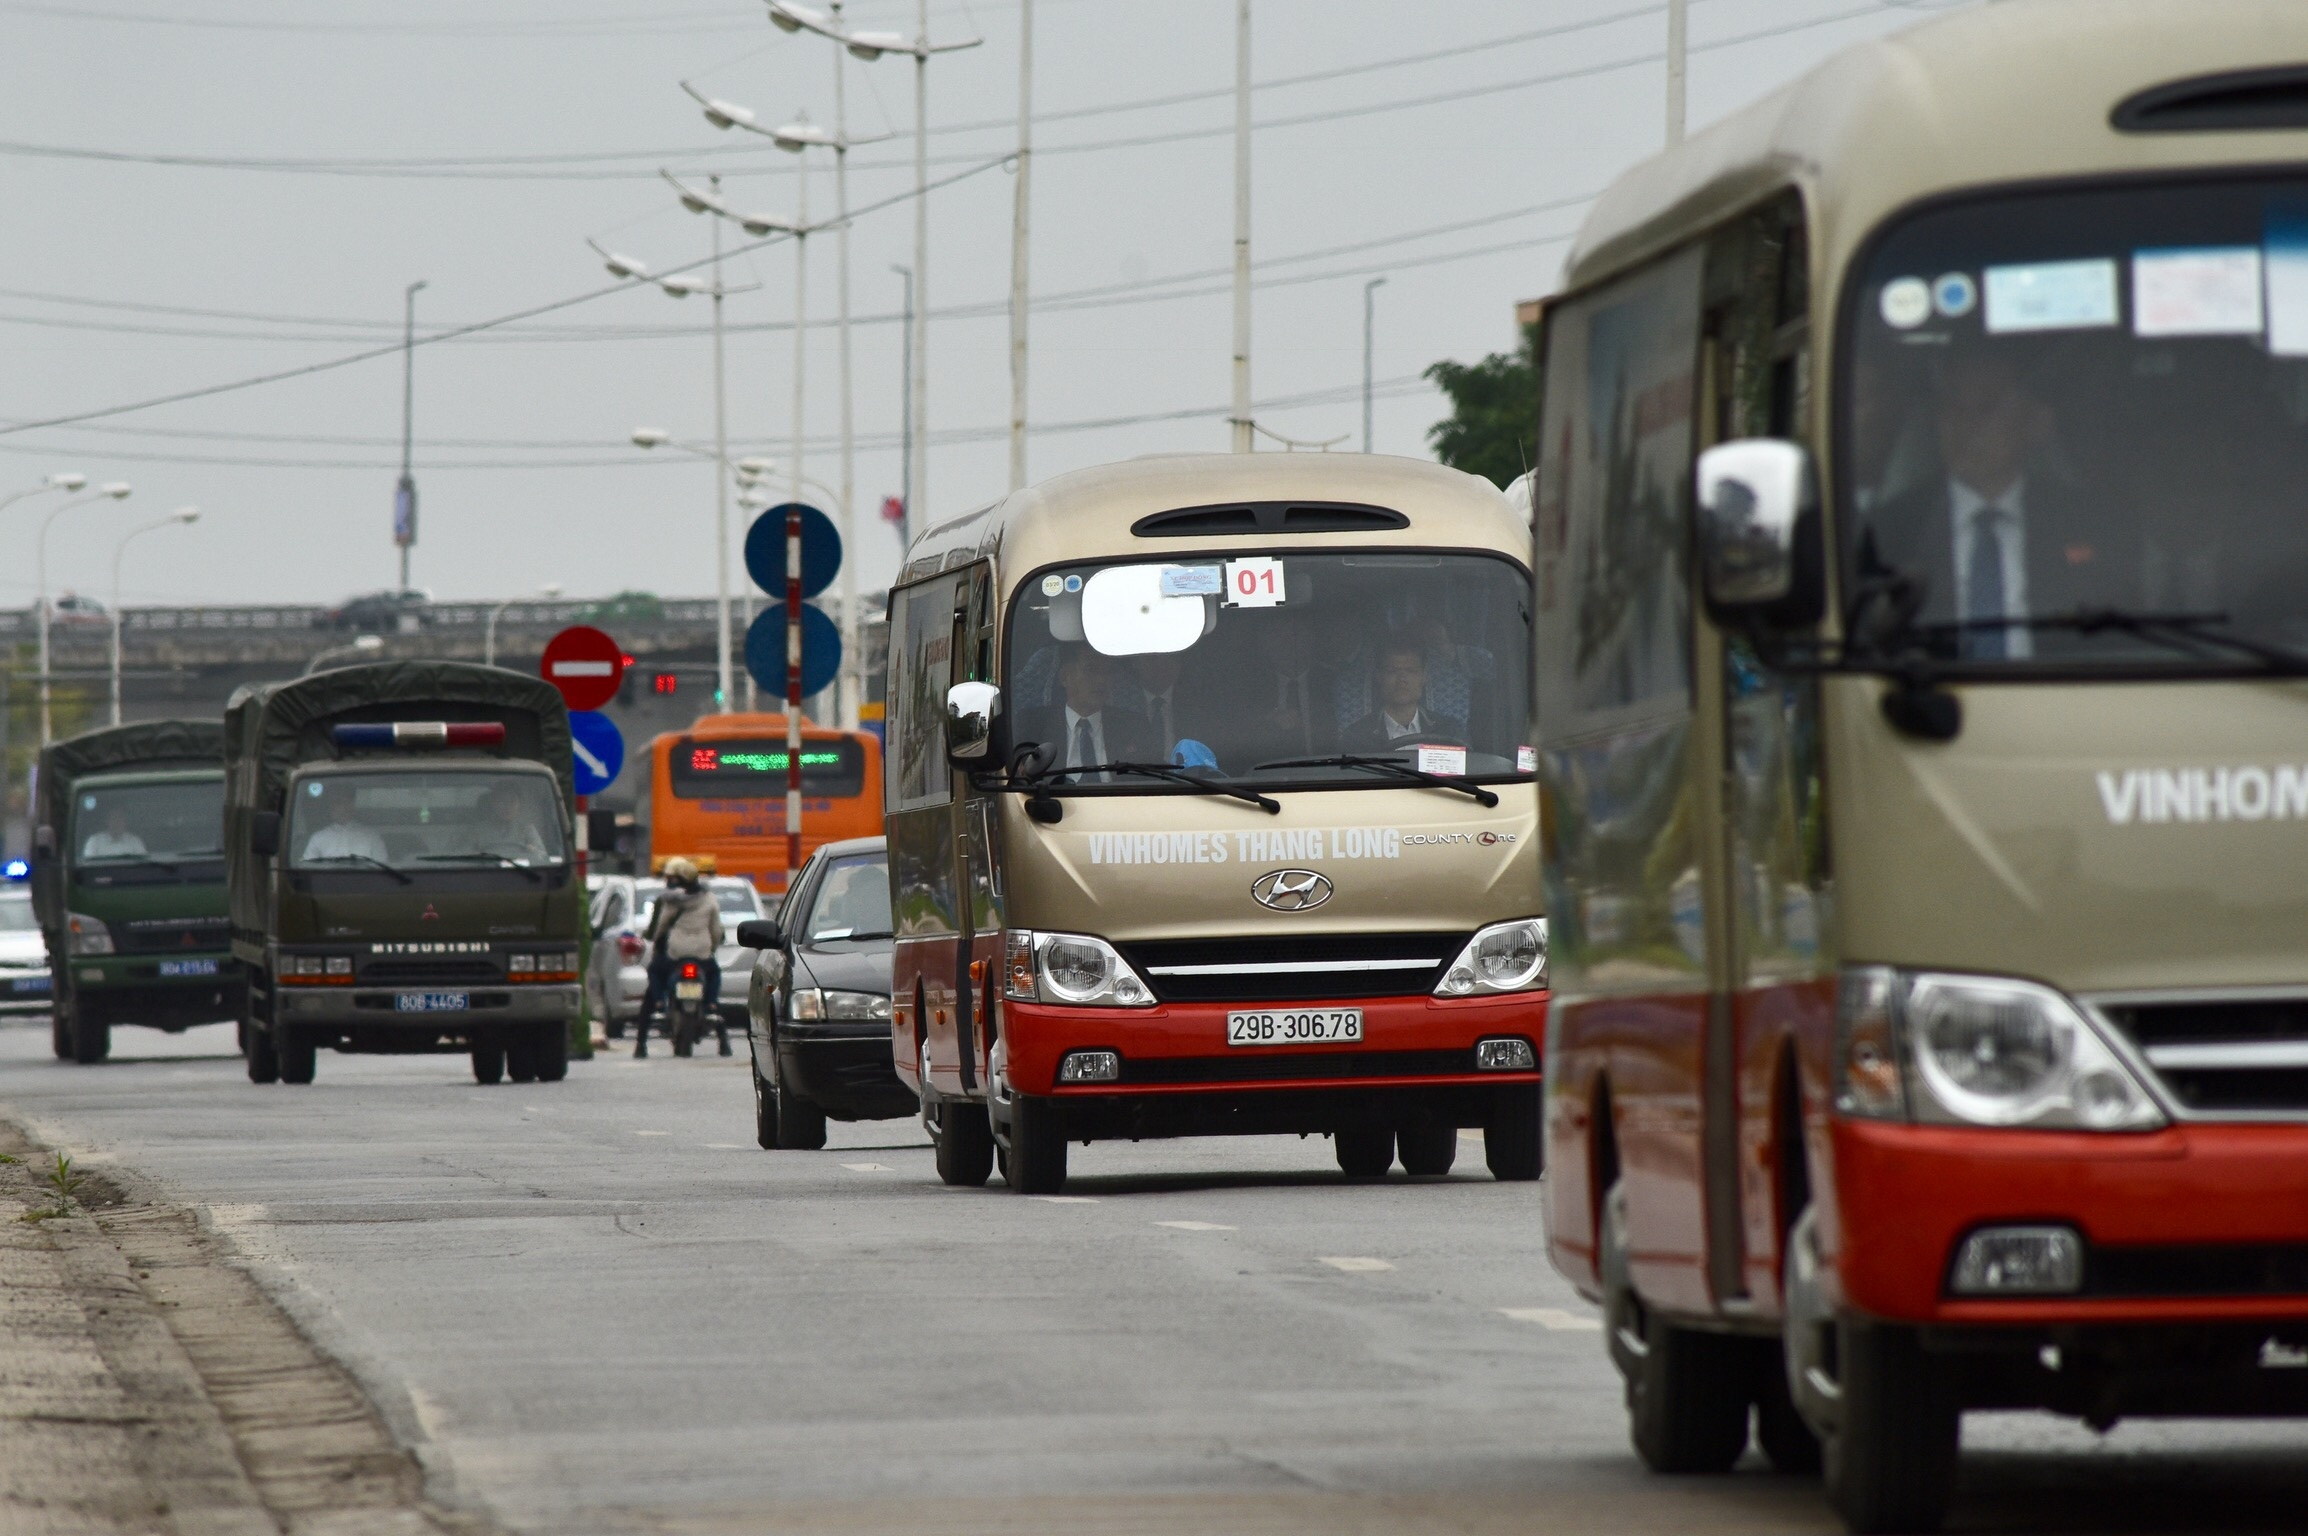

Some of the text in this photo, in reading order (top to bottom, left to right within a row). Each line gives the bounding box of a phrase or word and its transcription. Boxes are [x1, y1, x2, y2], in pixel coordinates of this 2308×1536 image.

[1237, 568, 1275, 596] 01
[1088, 827, 1400, 864] VINHOMES THANG LONG
[1402, 833, 1475, 845] COUNTY
[371, 942, 491, 954] MITSUBISHI
[1232, 1012, 1358, 1041] 29B-306.78
